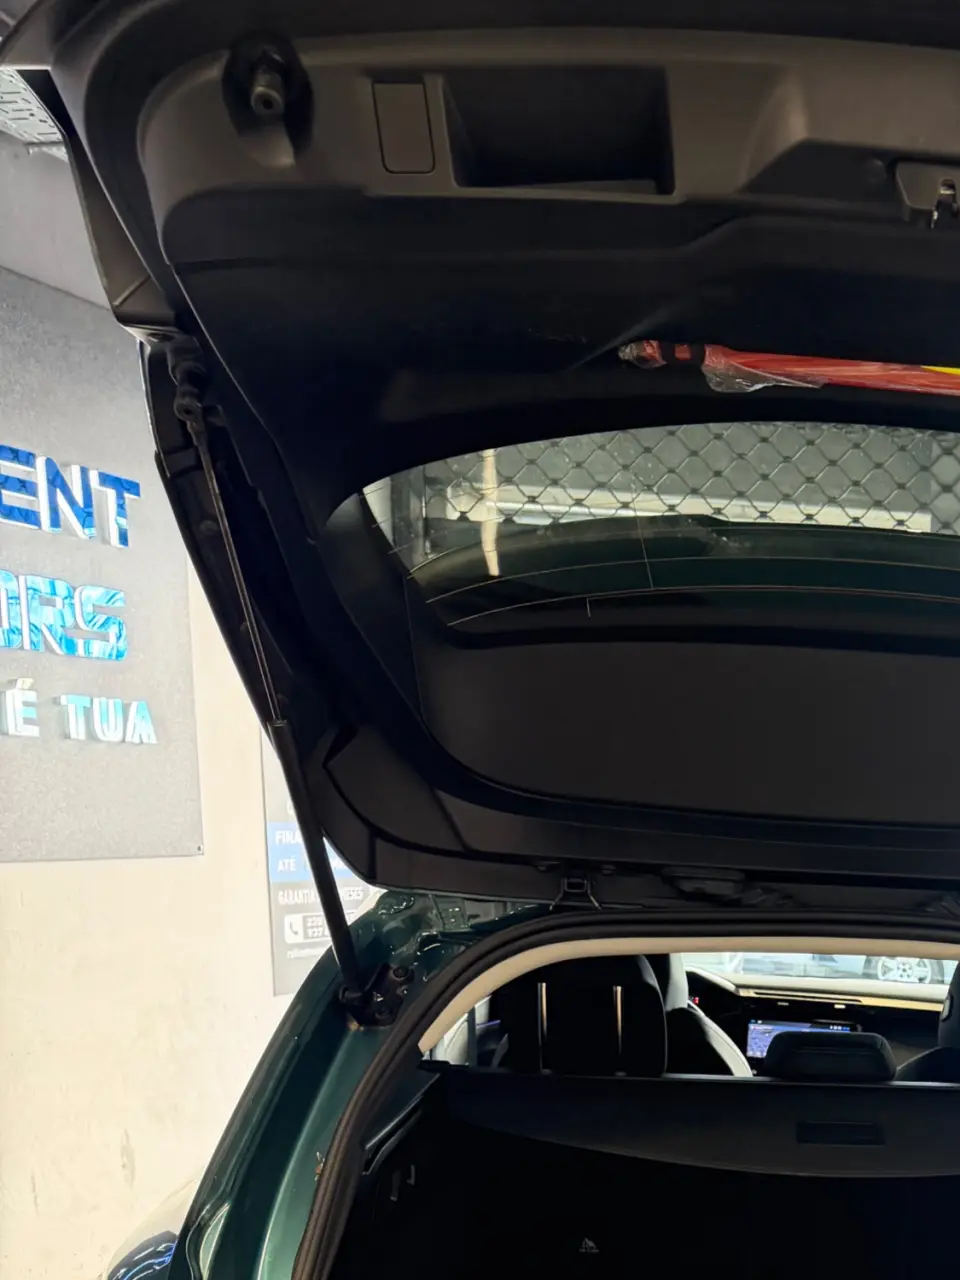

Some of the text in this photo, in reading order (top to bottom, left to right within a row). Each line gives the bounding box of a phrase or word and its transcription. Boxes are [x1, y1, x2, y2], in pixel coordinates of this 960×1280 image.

[0, 444, 141, 548] ENT
[60, 693, 158, 744] TUA
[277, 855, 297, 873] ATÉ
